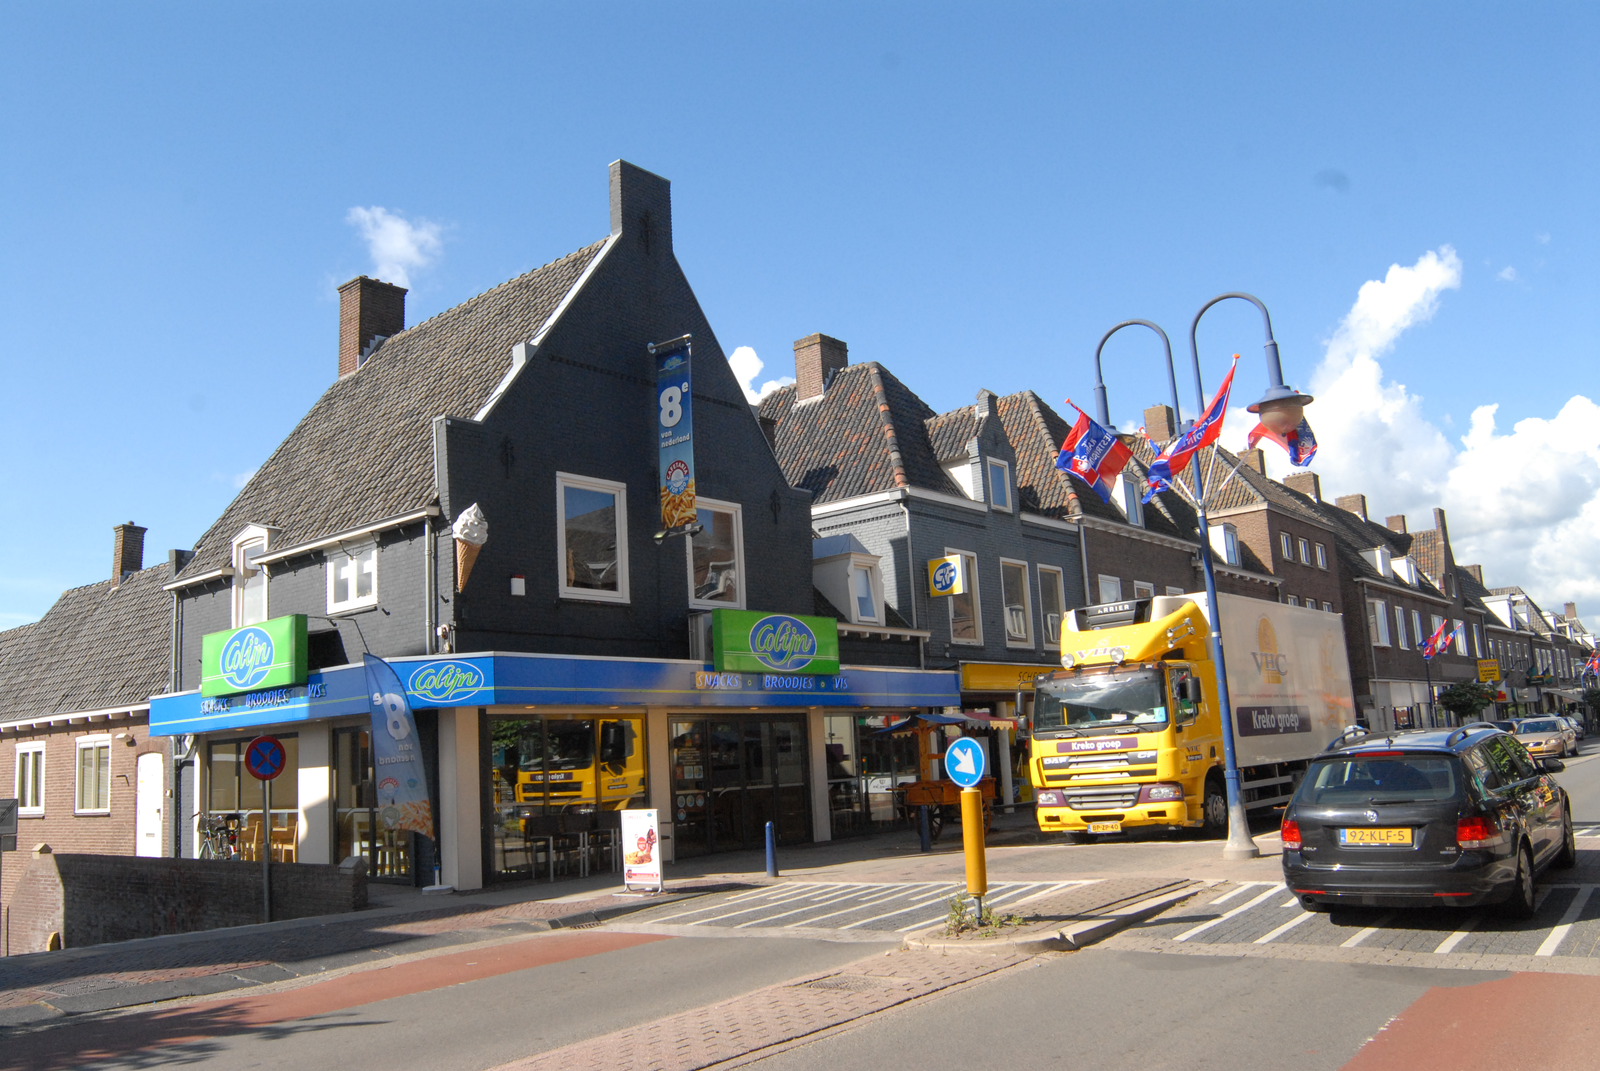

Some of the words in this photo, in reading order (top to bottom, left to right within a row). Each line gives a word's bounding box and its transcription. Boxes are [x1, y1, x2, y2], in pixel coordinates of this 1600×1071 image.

[661, 430, 673, 439] van
[661, 432, 690, 449] nederland
[756, 620, 812, 665] Colijn
[225, 632, 271, 684] Colijn
[1250, 650, 1289, 677] VHC
[415, 664, 478, 699] Colijn
[698, 674, 739, 689] SNACKS
[764, 674, 813, 691] BROODJES
[834, 677, 849, 690] VIS
[1017, 671, 1043, 682] SCHE
[245, 688, 288, 709] BROODJES
[308, 683, 323, 698] VIS
[1252, 710, 1276, 729] Kreko
[1278, 713, 1299, 733] groep
[1071, 741, 1096, 751] Kreko
[1096, 739, 1122, 751] groep
[1349, 830, 1405, 841] 92-KLF-5
